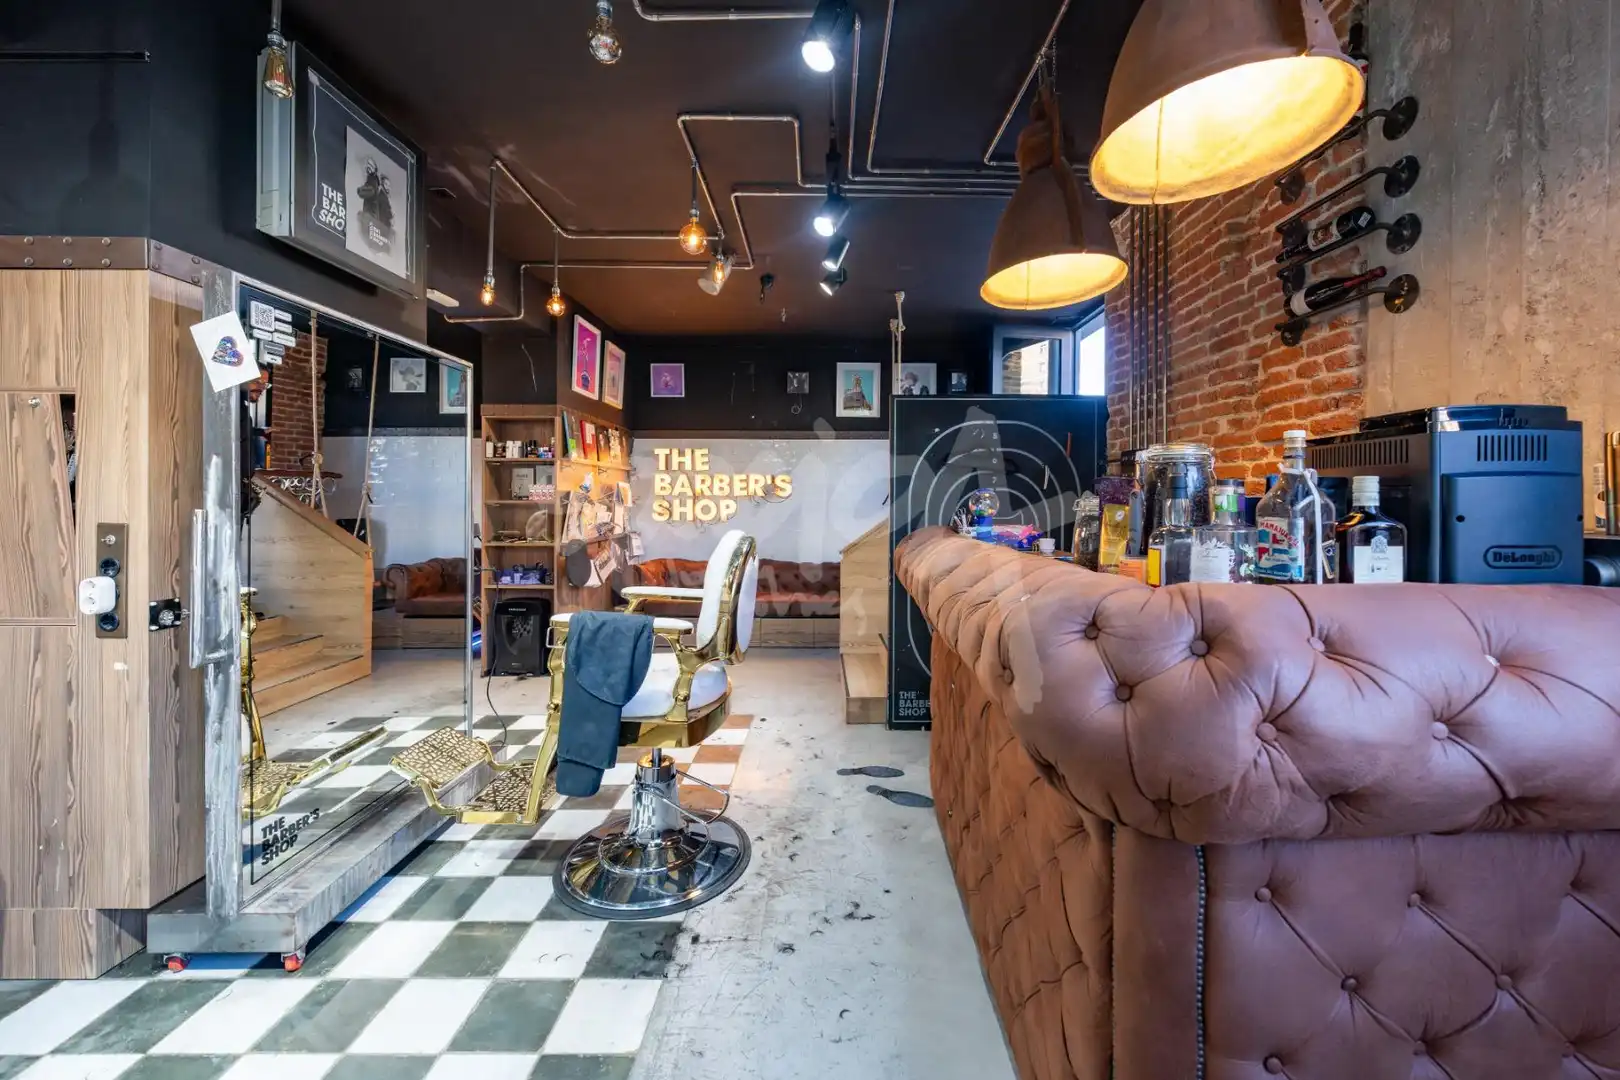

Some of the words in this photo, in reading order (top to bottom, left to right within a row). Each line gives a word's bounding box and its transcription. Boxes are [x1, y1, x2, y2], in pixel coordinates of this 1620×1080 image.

[321, 182, 343, 205] THE
[318, 208, 345, 231] SHO
[653, 448, 710, 471] THE
[654, 472, 793, 498] BARBER'S
[651, 498, 738, 523] SHOP
[899, 691, 917, 699] THE
[899, 700, 931, 708] BARBE
[898, 708, 926, 716] SHOP
[261, 816, 285, 839] THE
[262, 808, 320, 852] BARBER'S
[261, 834, 298, 866] SHOP
